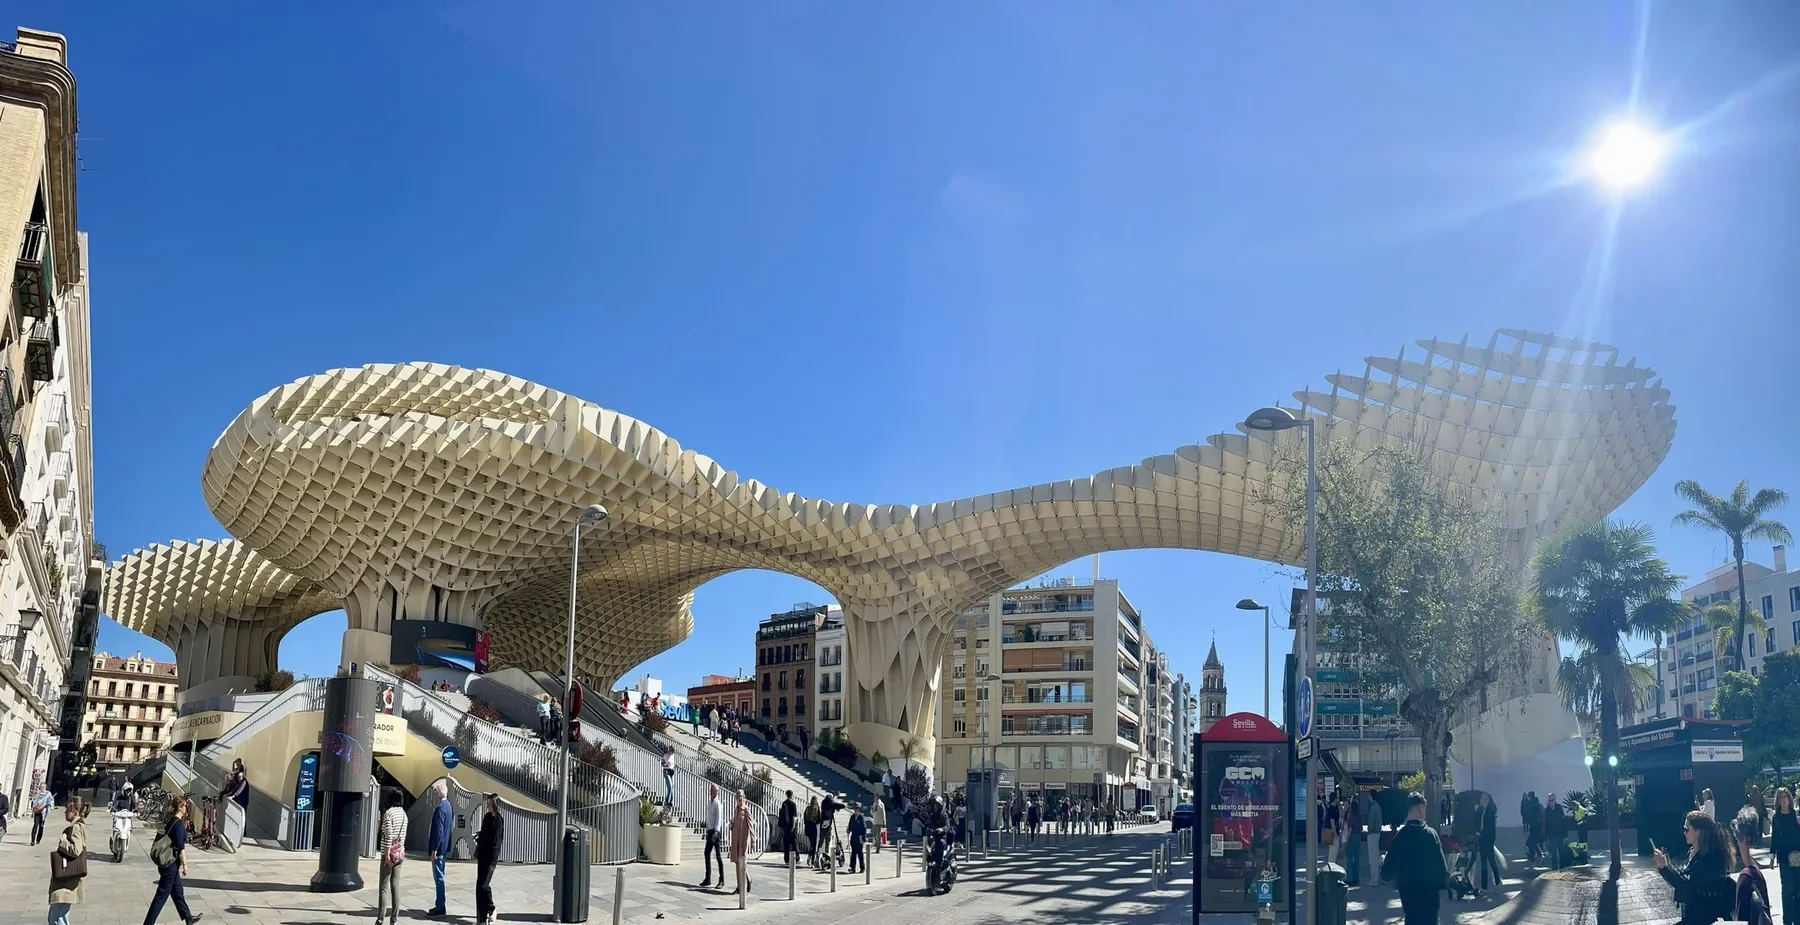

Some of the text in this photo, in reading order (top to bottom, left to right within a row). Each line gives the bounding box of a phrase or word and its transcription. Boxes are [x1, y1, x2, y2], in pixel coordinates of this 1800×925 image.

[660, 699, 690, 721] Sevill
[373, 723, 395, 732] RADOR
[1658, 731, 1674, 740] Estado
